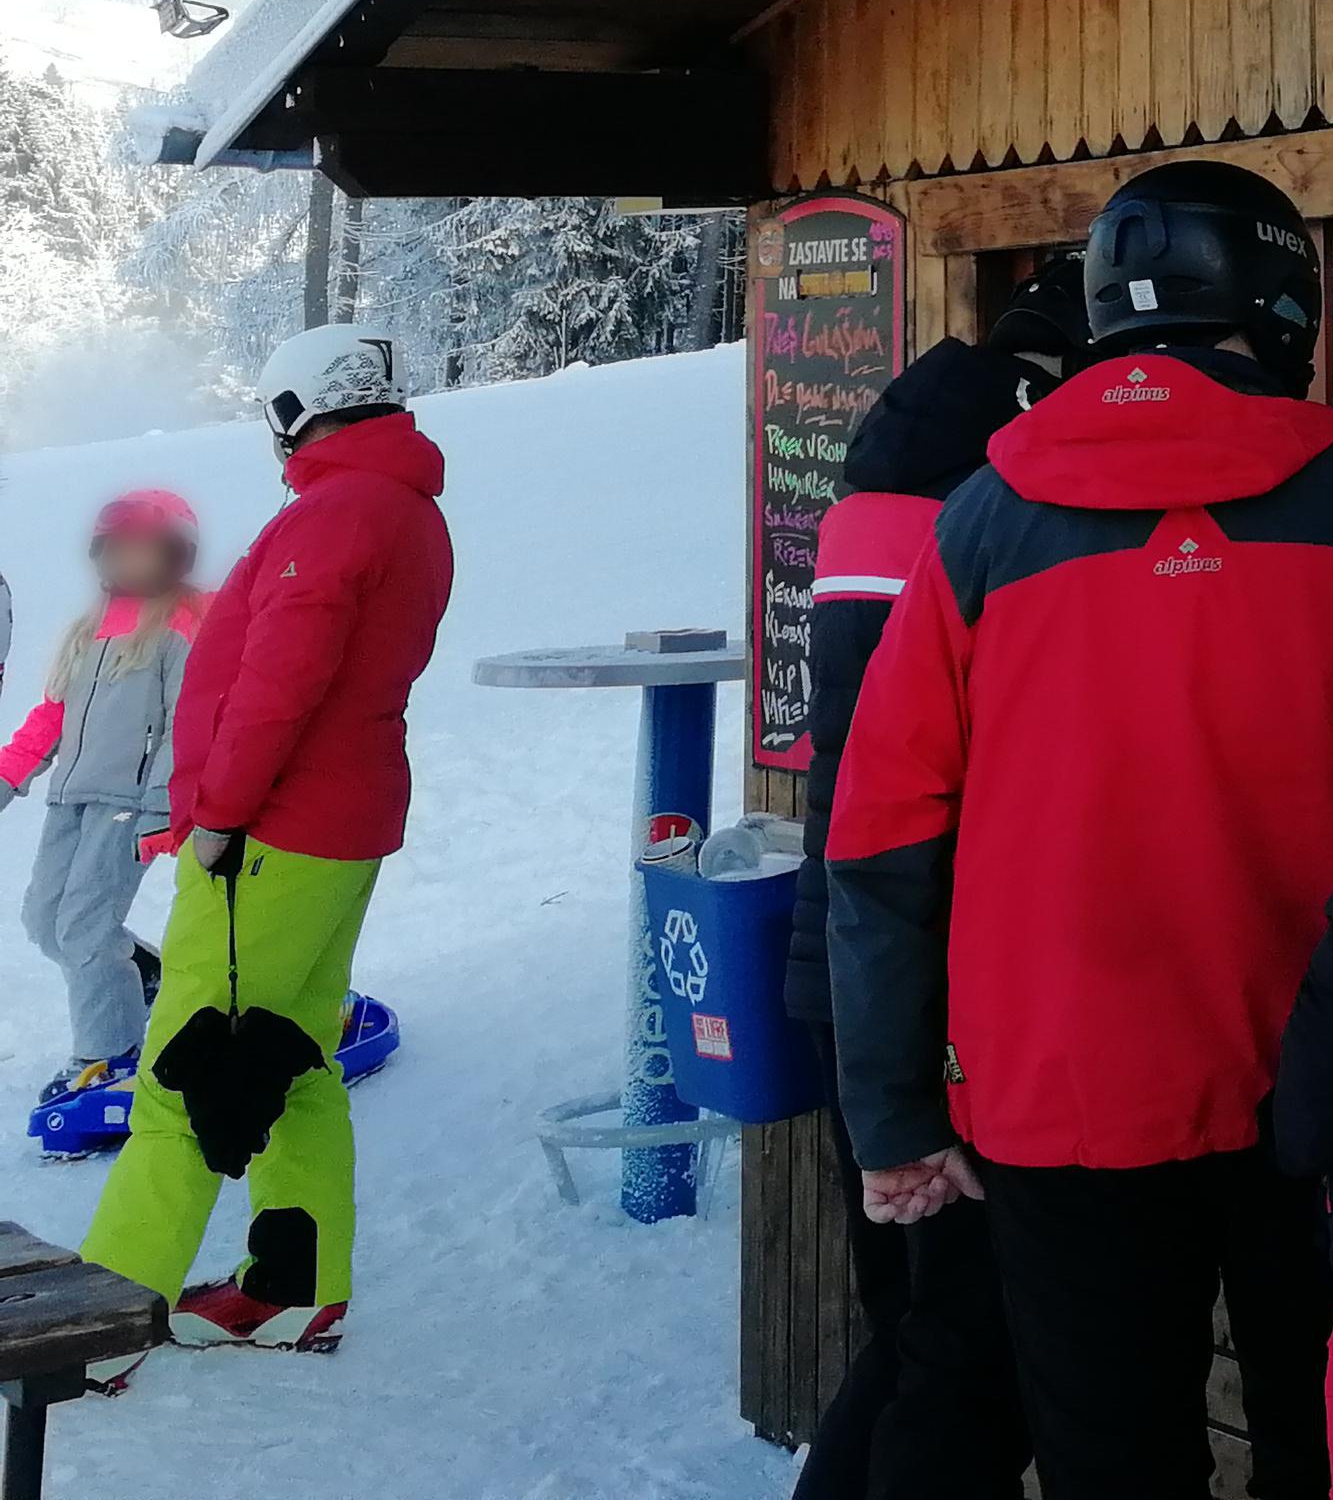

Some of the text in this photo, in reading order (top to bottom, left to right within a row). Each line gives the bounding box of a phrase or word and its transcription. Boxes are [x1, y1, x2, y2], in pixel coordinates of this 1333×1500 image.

[788, 238, 848, 265] ZASTAVTE
[851, 237, 868, 262] SE
[1256, 221, 1308, 258] uvex
[1102, 384, 1170, 405] alpinus
[1153, 555, 1222, 577] alpinus
